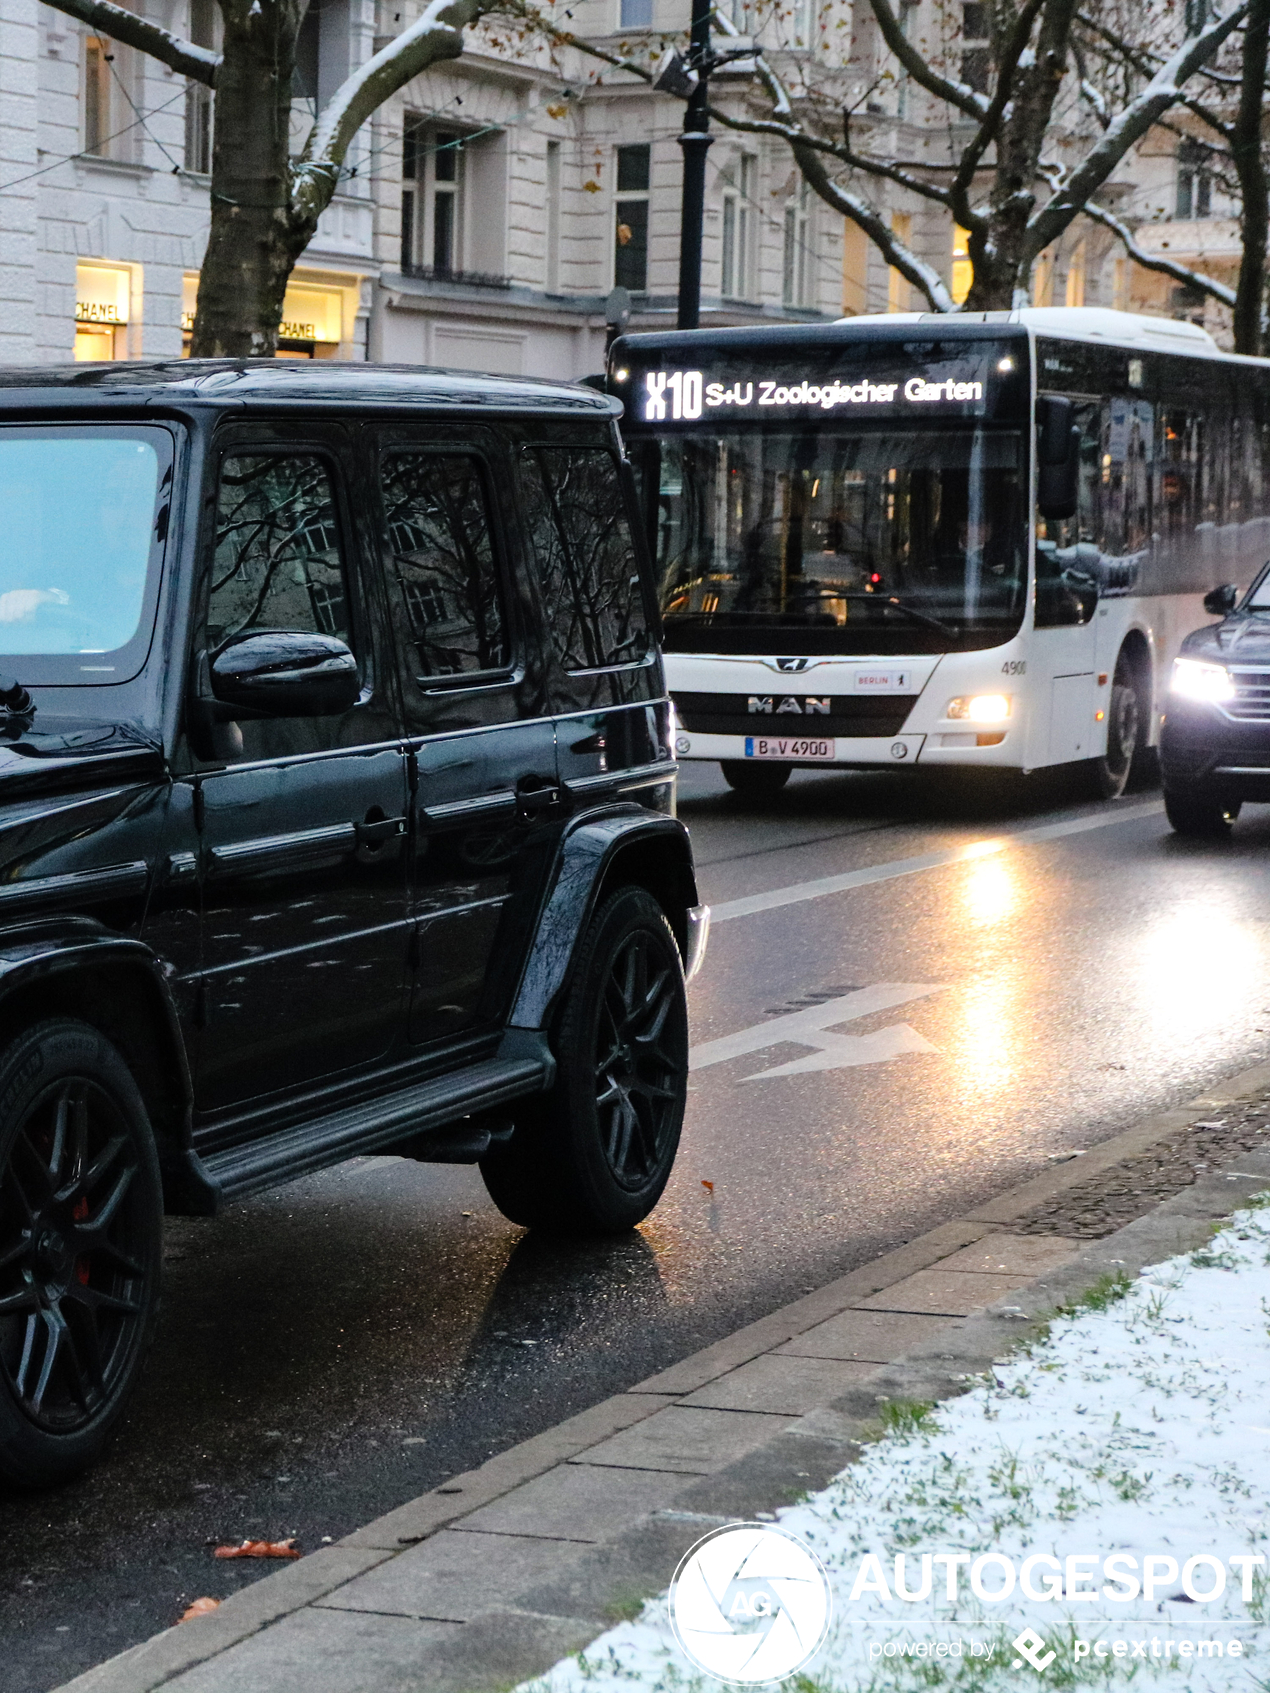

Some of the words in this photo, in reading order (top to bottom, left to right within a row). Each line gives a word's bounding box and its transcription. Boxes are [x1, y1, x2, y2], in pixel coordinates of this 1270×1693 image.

[645, 371, 703, 420] X10
[705, 382, 754, 406] S+U
[758, 379, 899, 409] Zoologischer
[904, 377, 983, 402] Garten
[858, 676, 889, 685] BERLIN
[747, 696, 832, 715] MAN
[759, 740, 769, 755] B
[778, 740, 788, 756] V
[791, 741, 828, 757] 4900
